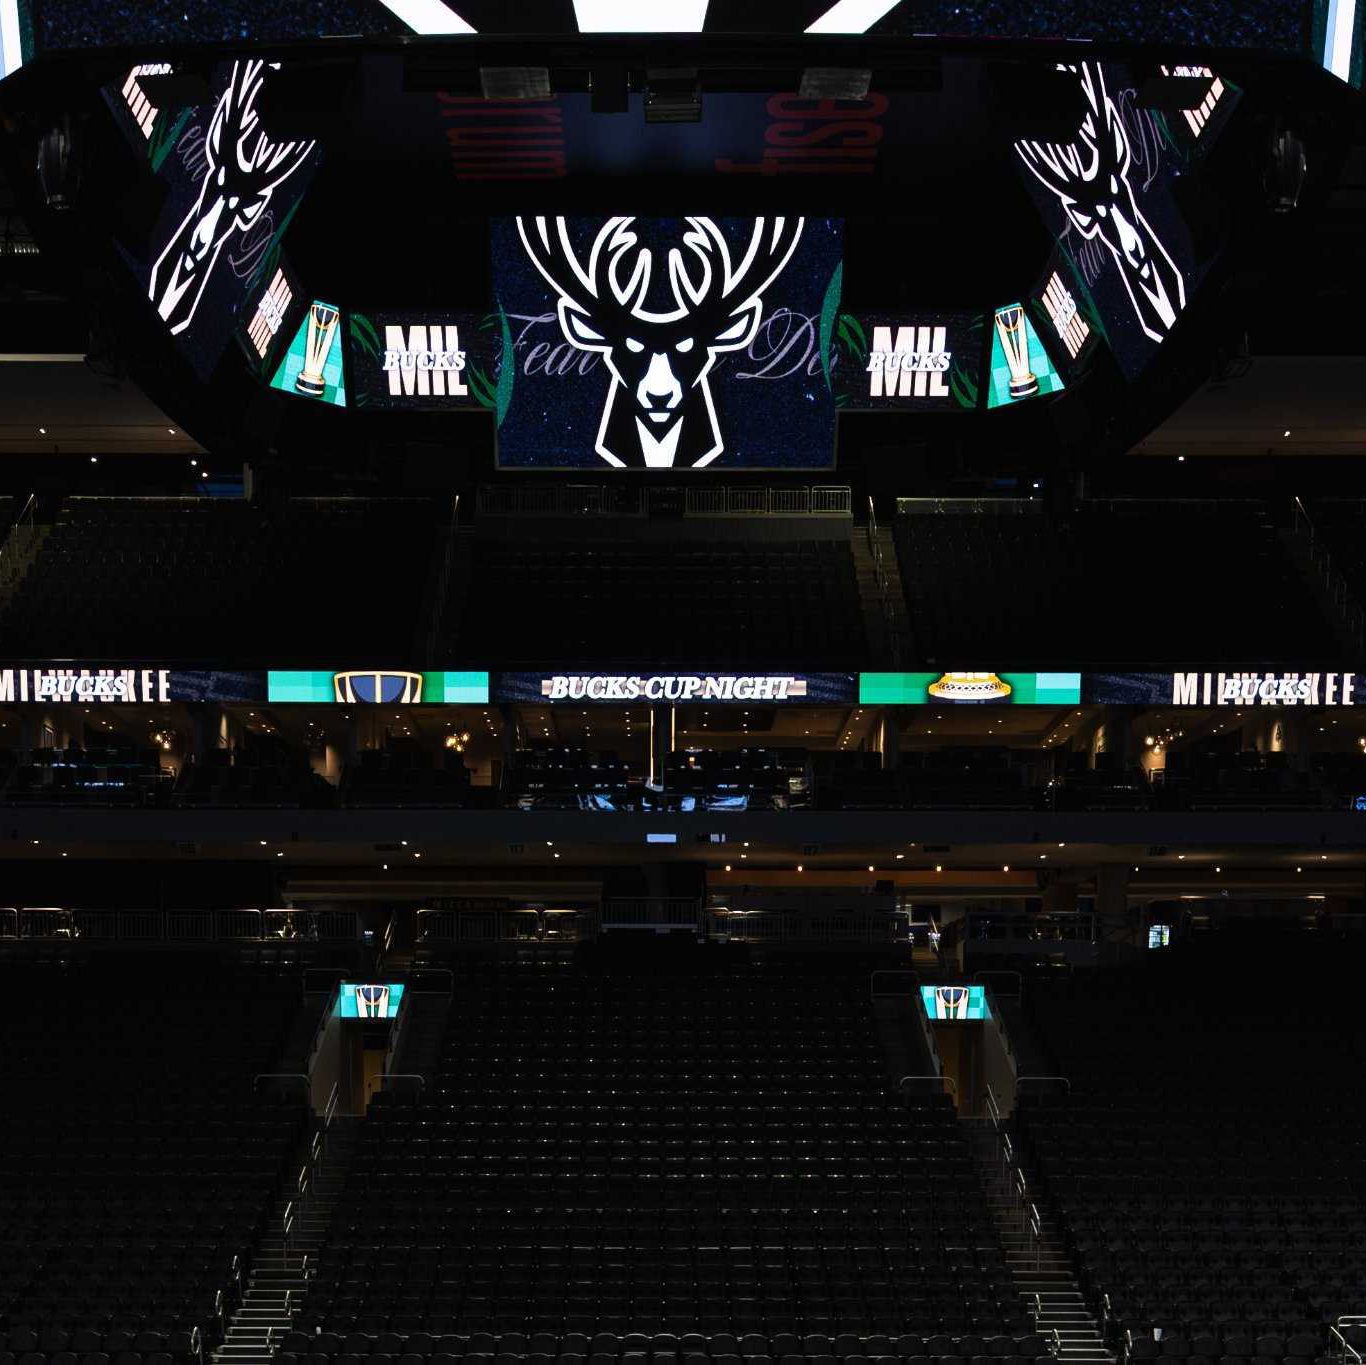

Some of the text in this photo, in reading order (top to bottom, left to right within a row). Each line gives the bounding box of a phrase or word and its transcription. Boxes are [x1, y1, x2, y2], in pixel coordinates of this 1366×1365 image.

[382, 351, 467, 372] BUCKS
[866, 351, 951, 372] BUCKS
[40, 675, 128, 696] BUCKS
[549, 675, 795, 700] BUCKS CUP NIGHT
[1172, 672, 1356, 705] MILWAUKEE
[1223, 678, 1313, 700] BUCKS
